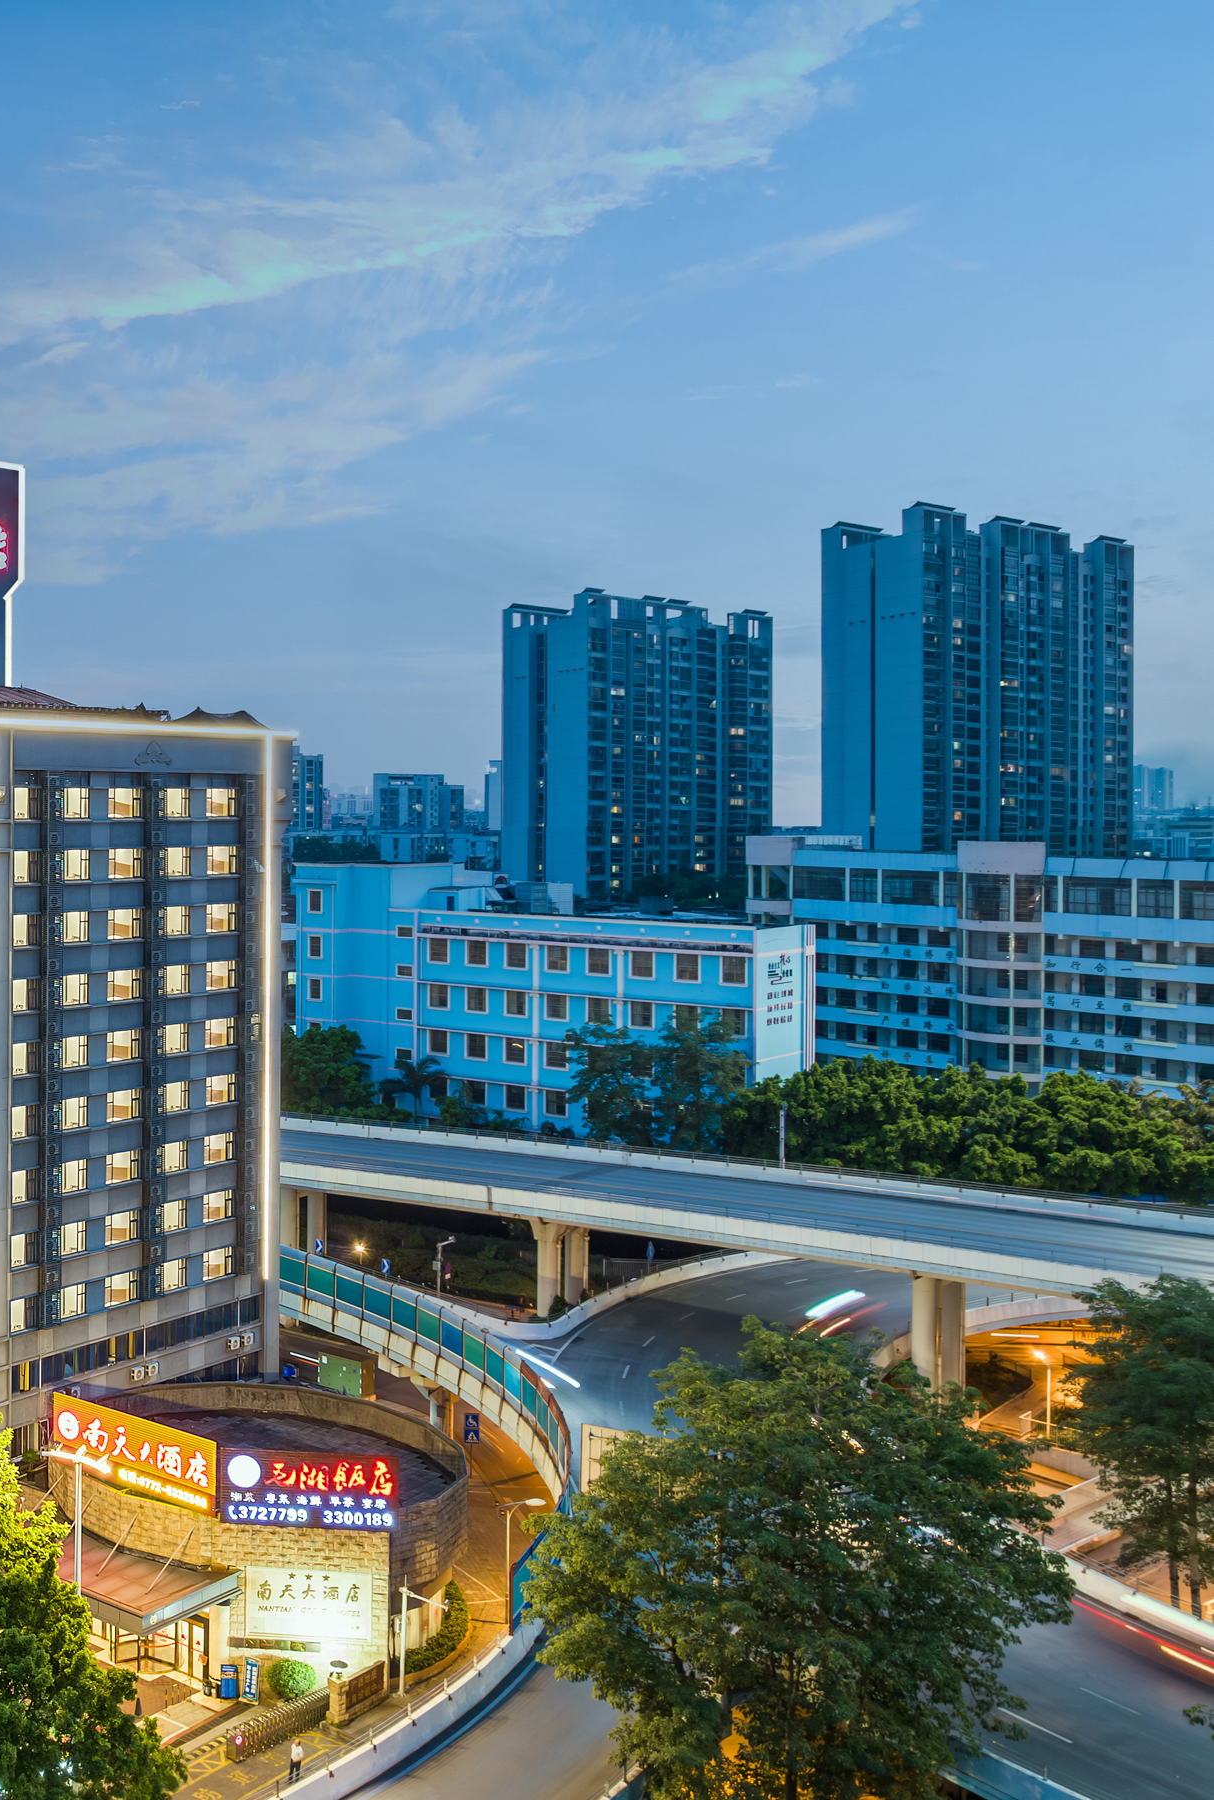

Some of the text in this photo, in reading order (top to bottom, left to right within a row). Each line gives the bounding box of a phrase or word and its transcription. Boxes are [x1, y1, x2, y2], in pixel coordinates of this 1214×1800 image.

[1044, 958, 1133, 973] 知行合一
[82, 1417, 210, 1488] 南天大酒店
[230, 1491, 256, 1503] 湘菜
[238, 1505, 394, 1527] 3727799 3300189
[257, 1579, 361, 1604] 南天大酒店
